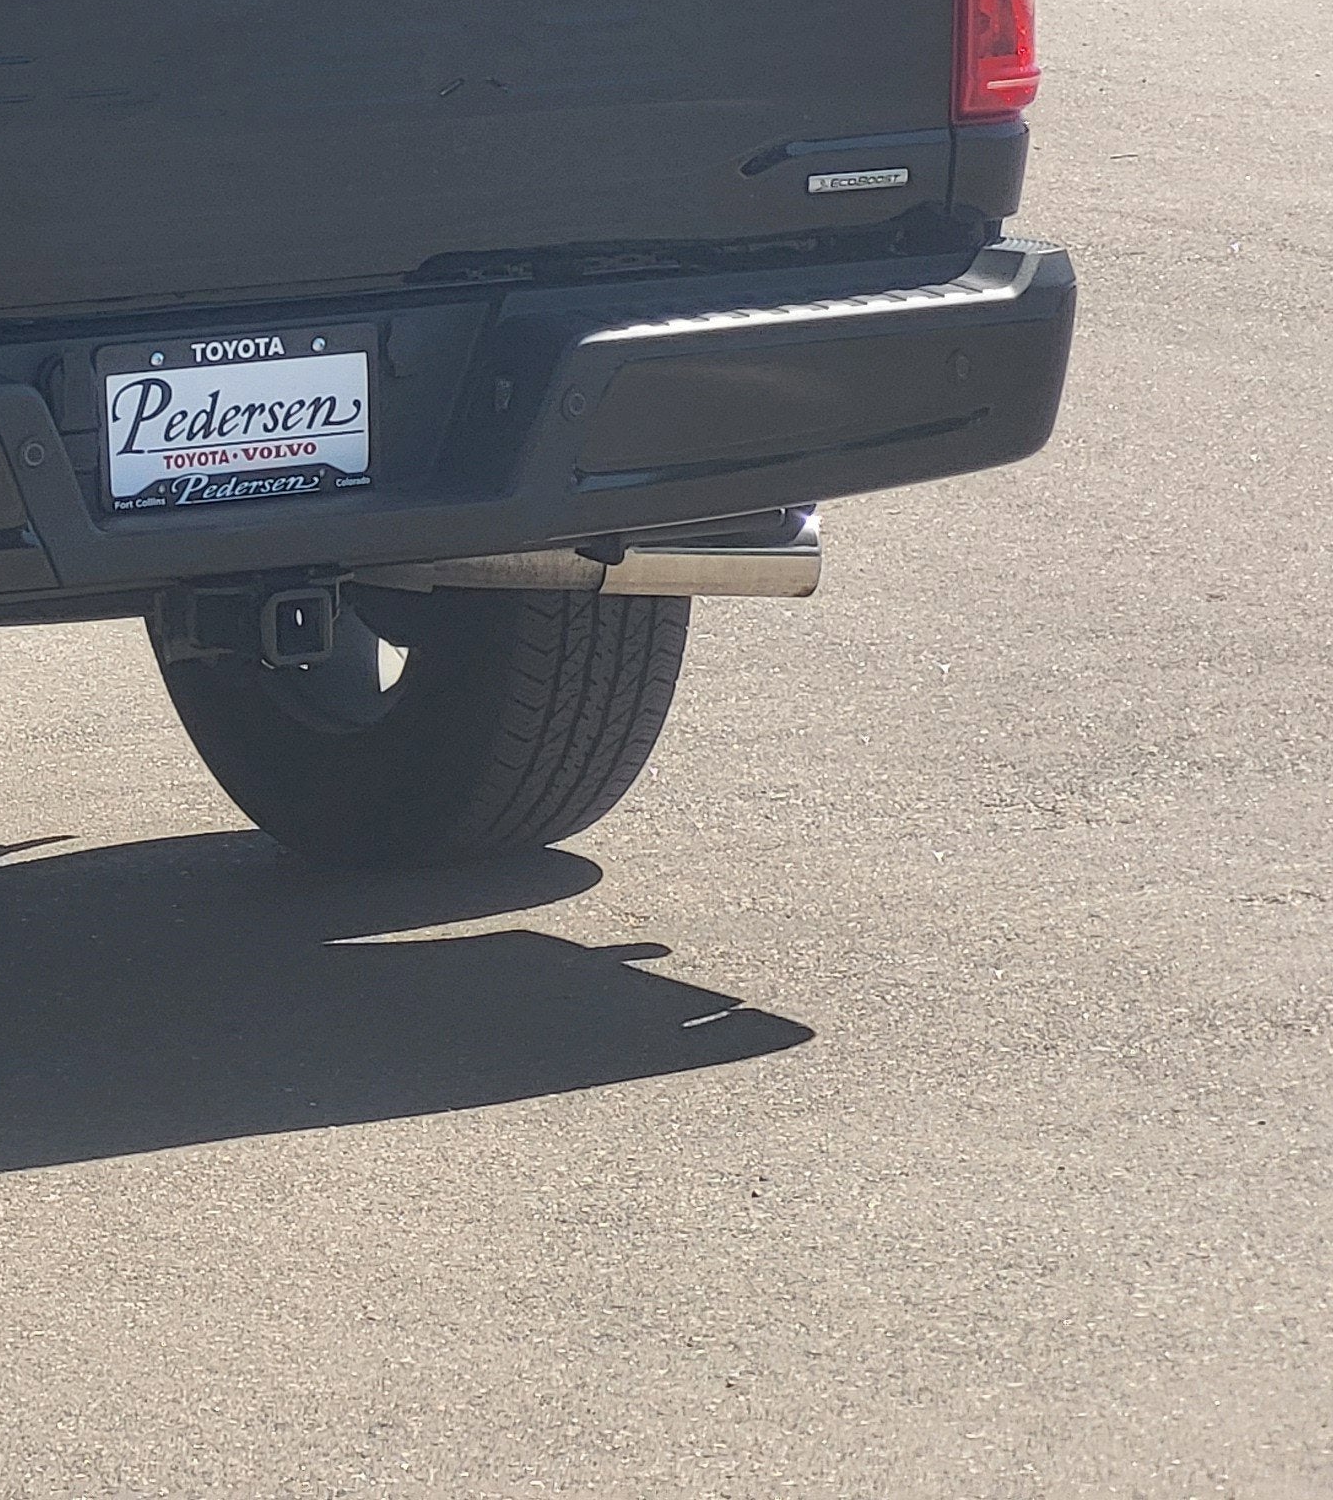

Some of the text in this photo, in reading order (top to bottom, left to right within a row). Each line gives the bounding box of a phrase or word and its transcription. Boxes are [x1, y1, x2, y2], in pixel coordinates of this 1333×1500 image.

[191, 337, 284, 363] TOYOTA
[112, 378, 361, 455] Pedersen
[164, 442, 317, 470] TOYOTA VOLVO
[114, 497, 166, 510] Fort Collins
[171, 474, 320, 505] Pedersen
